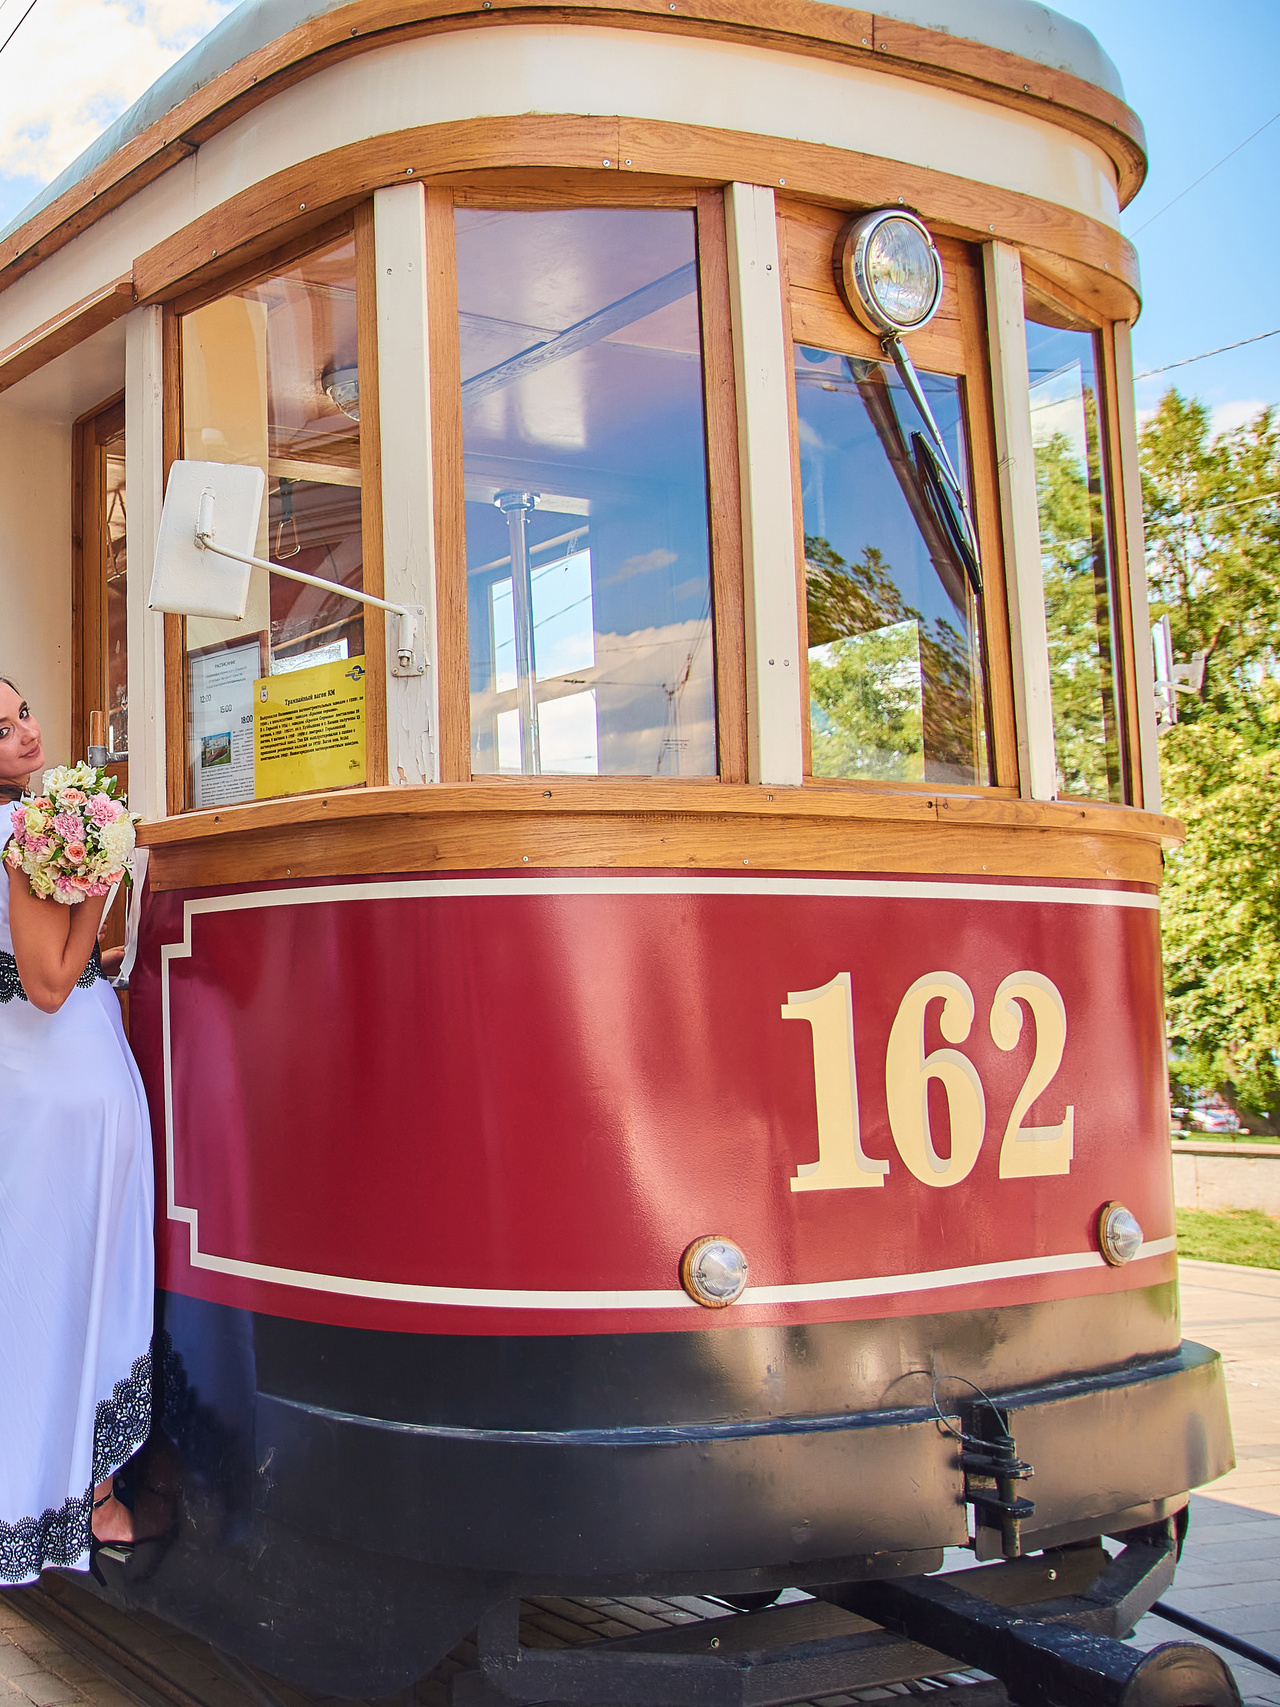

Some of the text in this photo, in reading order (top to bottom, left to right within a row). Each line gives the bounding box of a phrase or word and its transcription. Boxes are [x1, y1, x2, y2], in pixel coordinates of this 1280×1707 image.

[314, 692, 327, 700] вагон
[220, 704, 233, 713] 15:00
[241, 715, 254, 724] 18:00
[781, 971, 1074, 1192] 162
